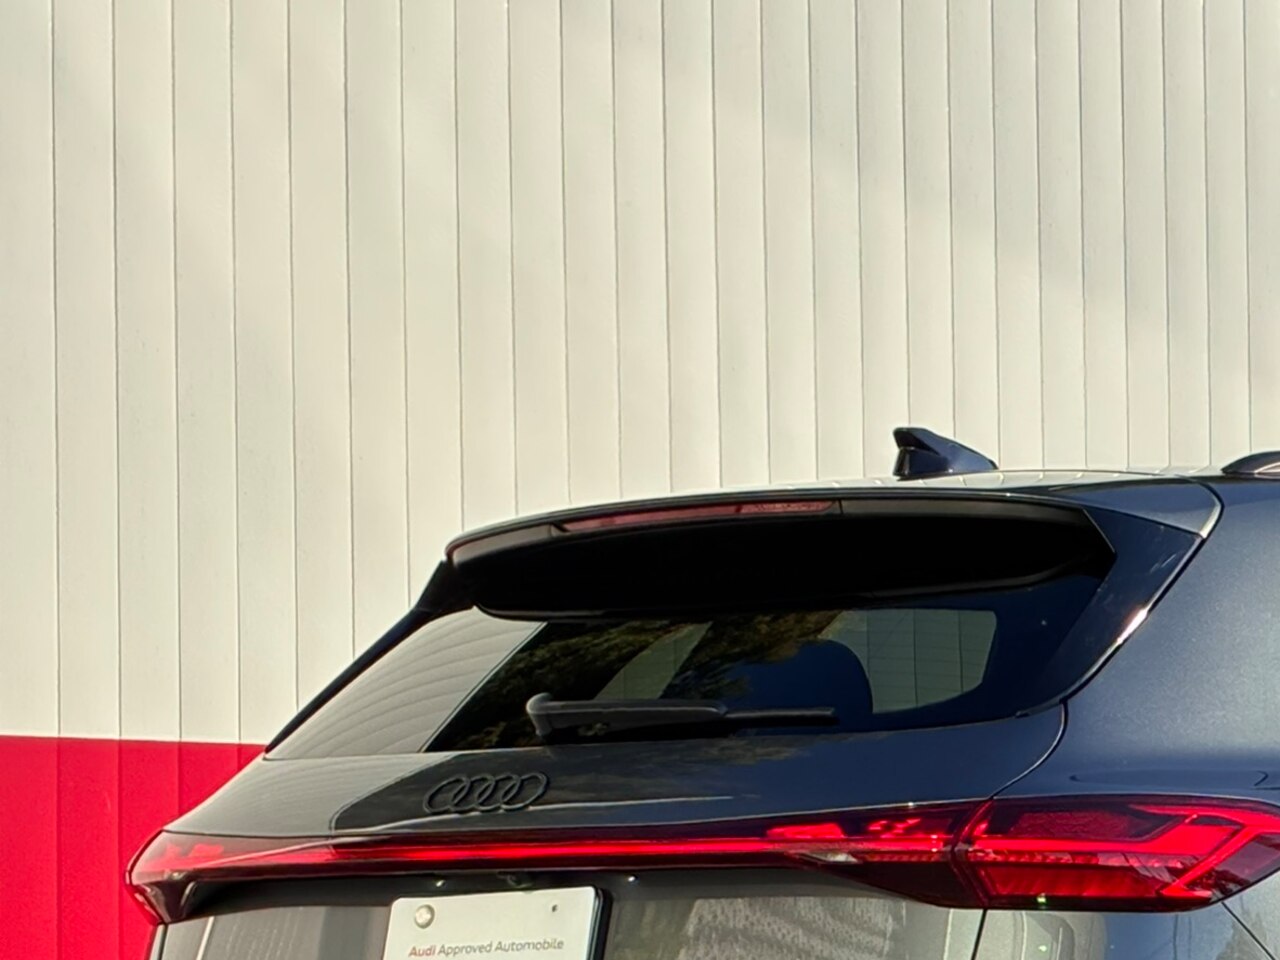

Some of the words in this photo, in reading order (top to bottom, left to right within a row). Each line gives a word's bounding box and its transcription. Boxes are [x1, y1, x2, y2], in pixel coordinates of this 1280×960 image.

[408, 945, 437, 957] Audi
[437, 941, 493, 957] Approved
[494, 938, 564, 952] Automobile
